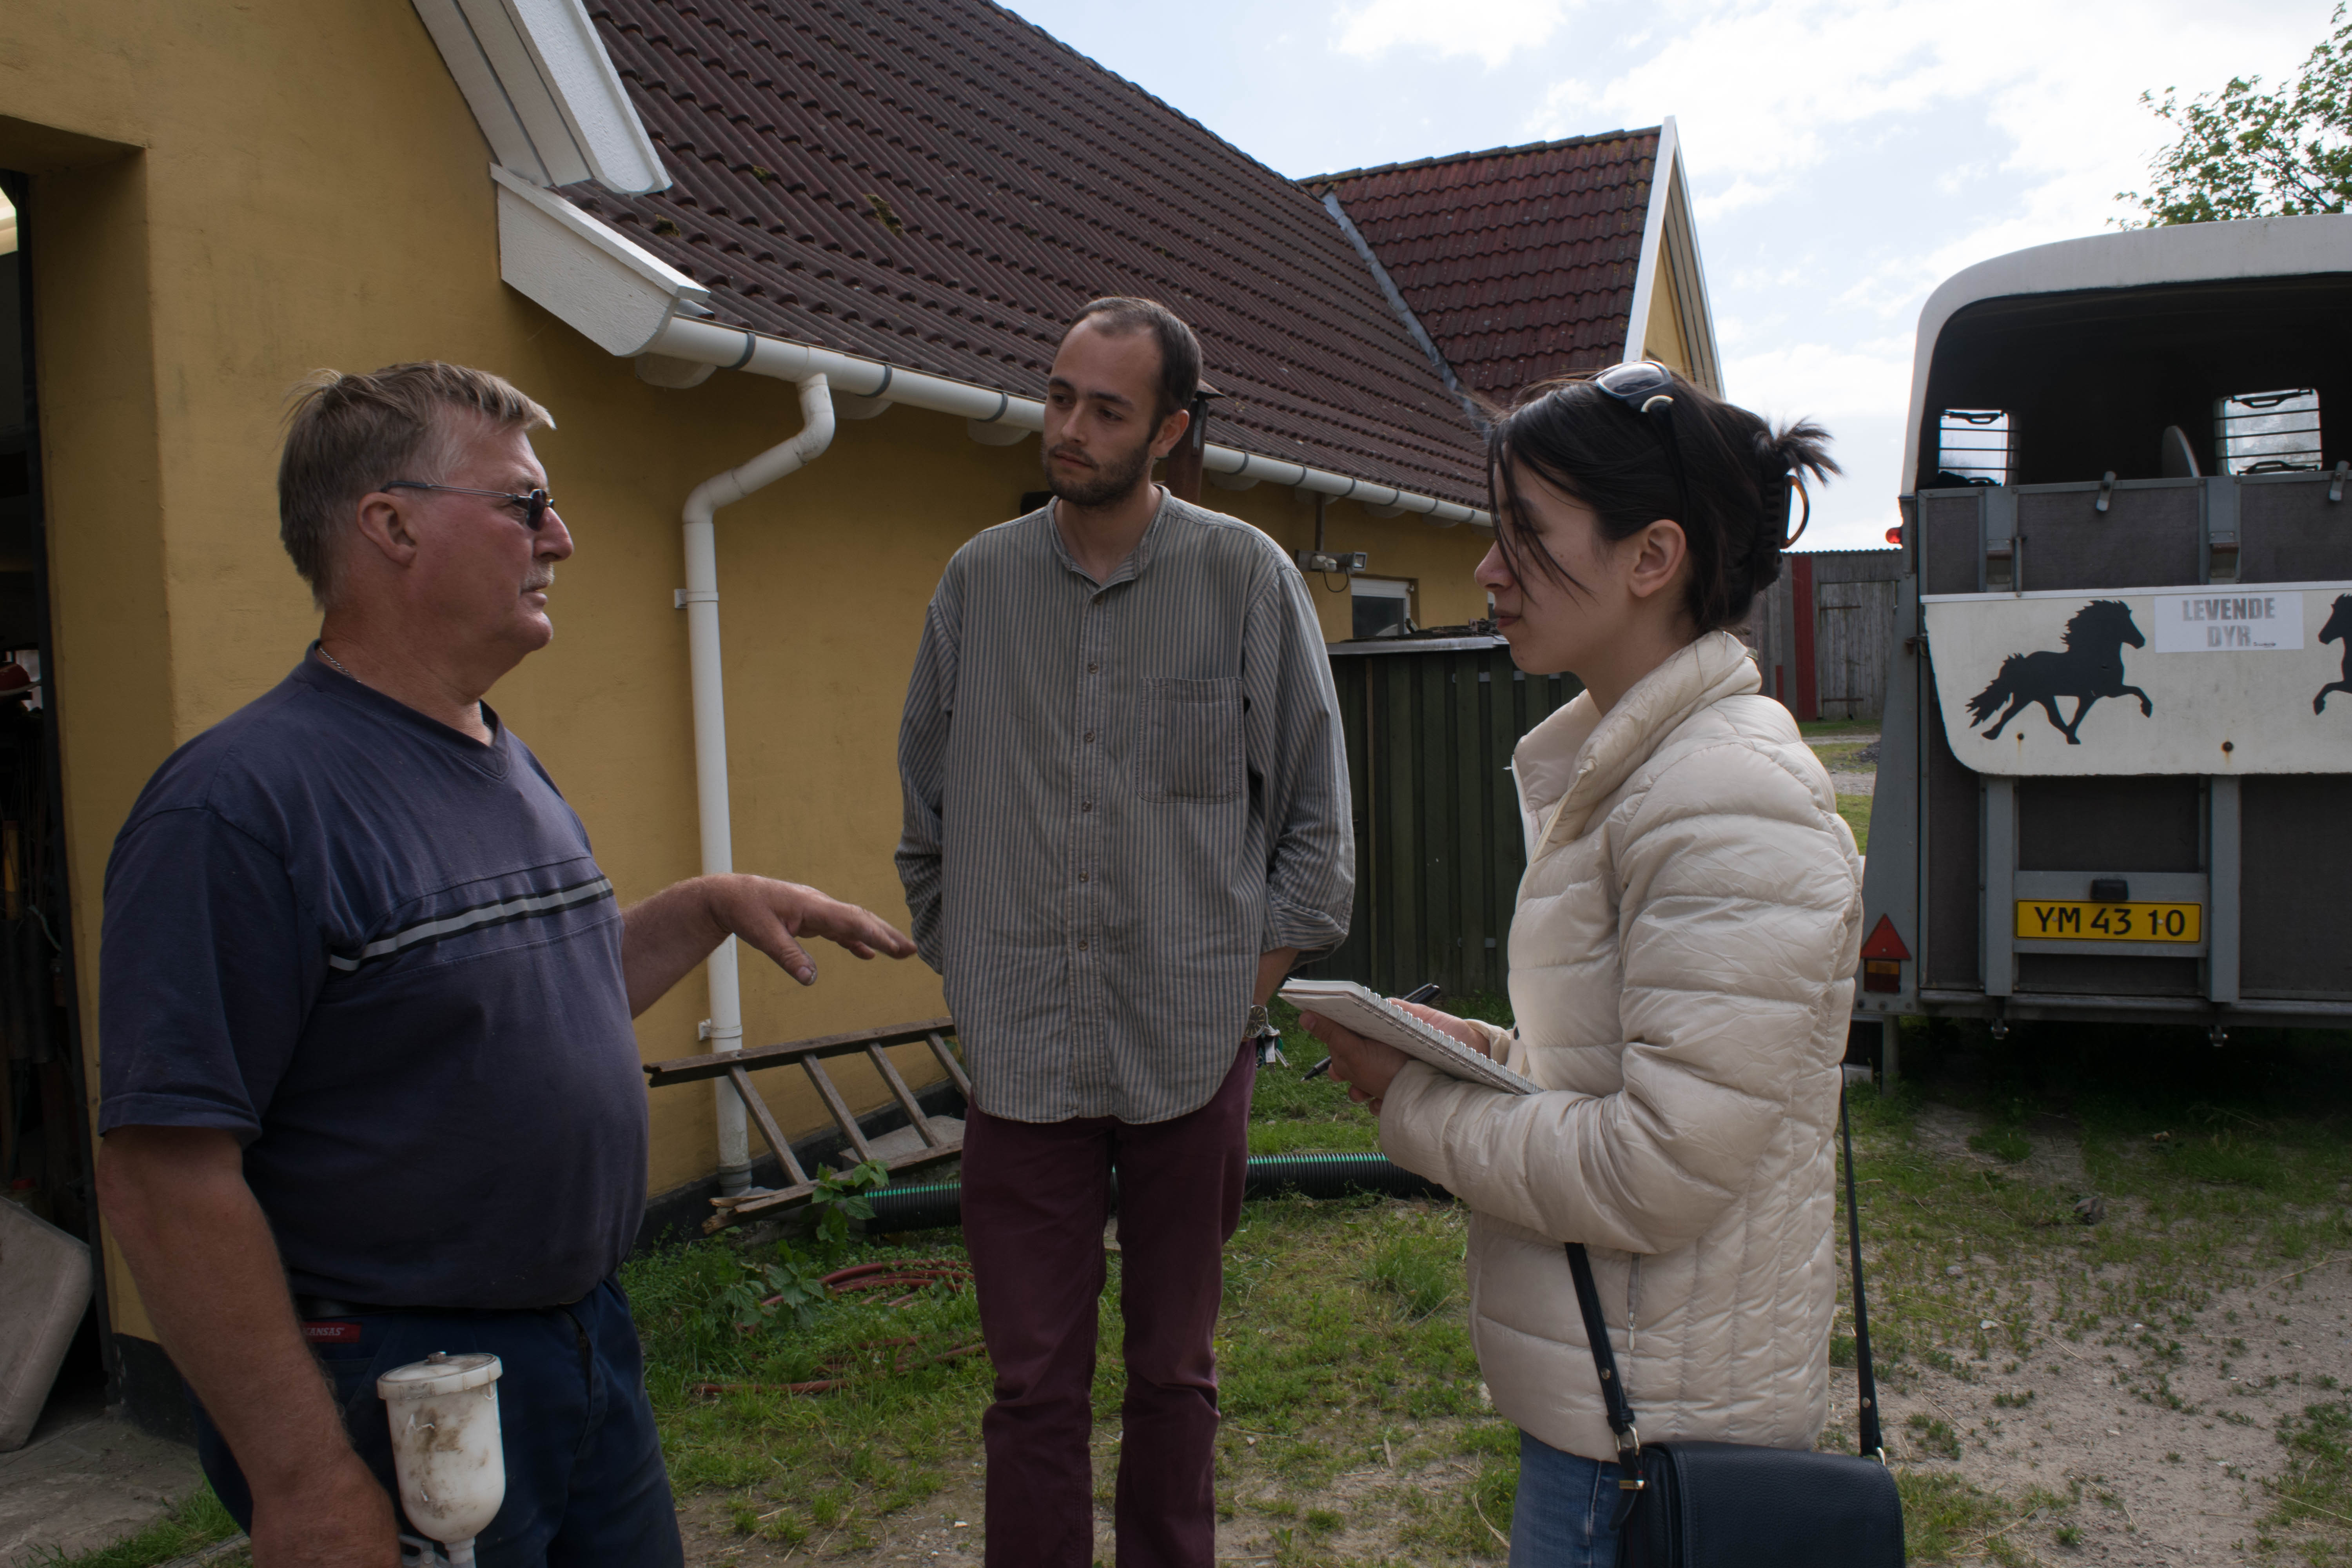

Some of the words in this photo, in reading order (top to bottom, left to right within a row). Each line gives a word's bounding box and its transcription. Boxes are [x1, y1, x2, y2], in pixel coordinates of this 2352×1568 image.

[2182, 597, 2275, 621] LEVENDE
[2207, 625, 2251, 648] DYR
[2034, 906, 2080, 933] YM
[2091, 908, 2132, 935] 43
[2148, 909, 2185, 936] 10
